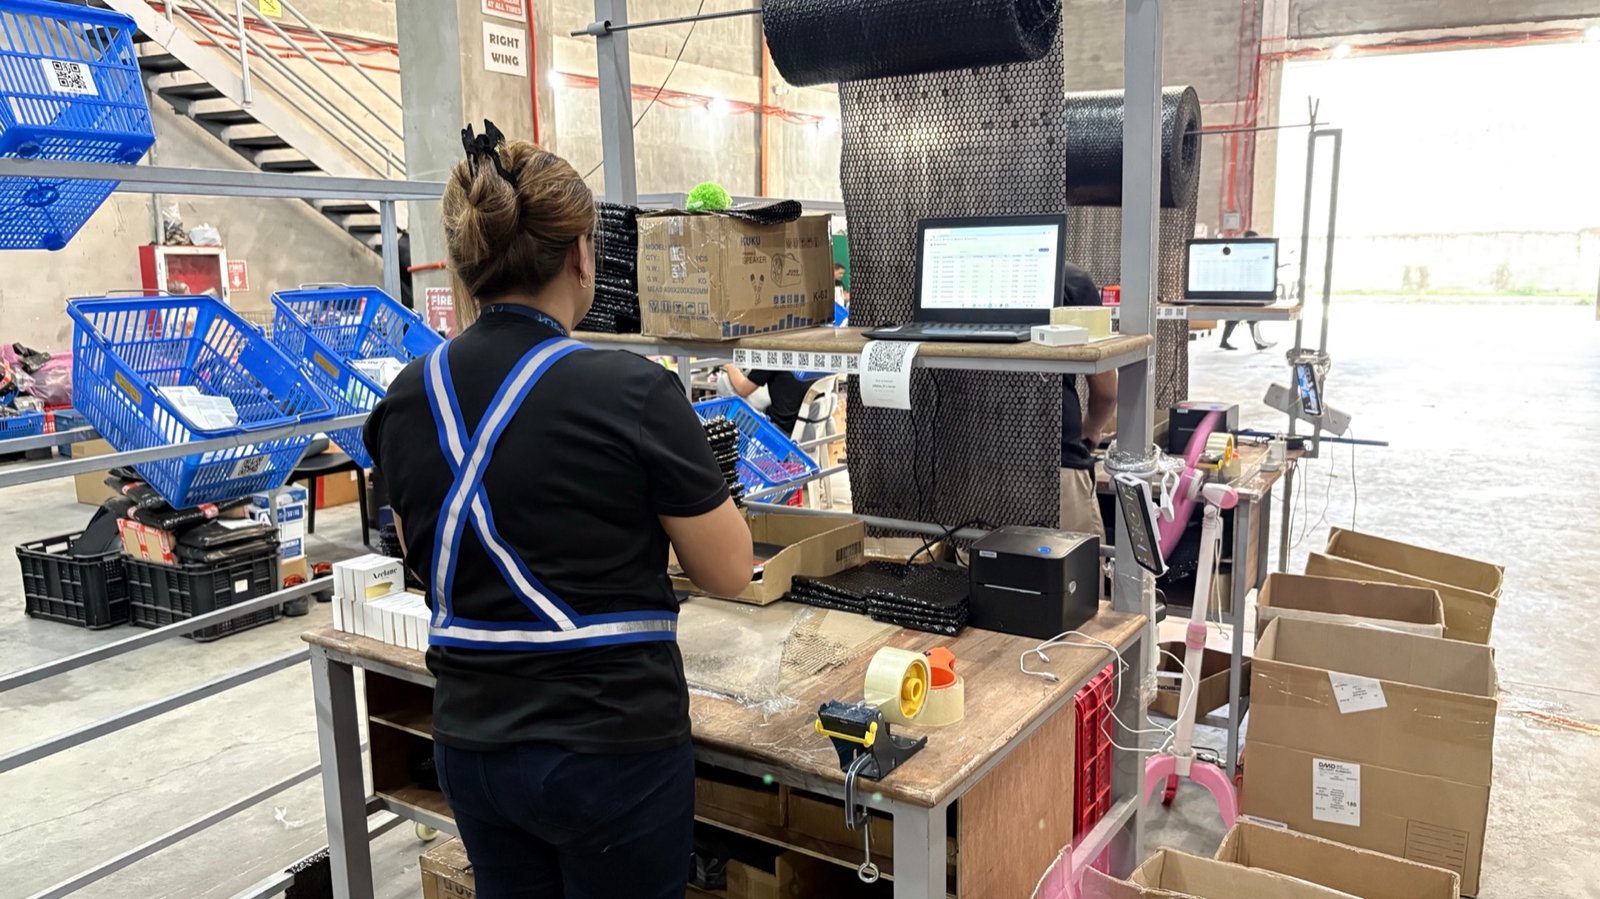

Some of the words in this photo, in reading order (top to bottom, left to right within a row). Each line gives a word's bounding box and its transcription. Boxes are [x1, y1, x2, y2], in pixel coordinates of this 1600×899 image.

[489, 33, 519, 48] RIGHT
[491, 52, 519, 66] WING
[431, 295, 453, 305] FIRE
